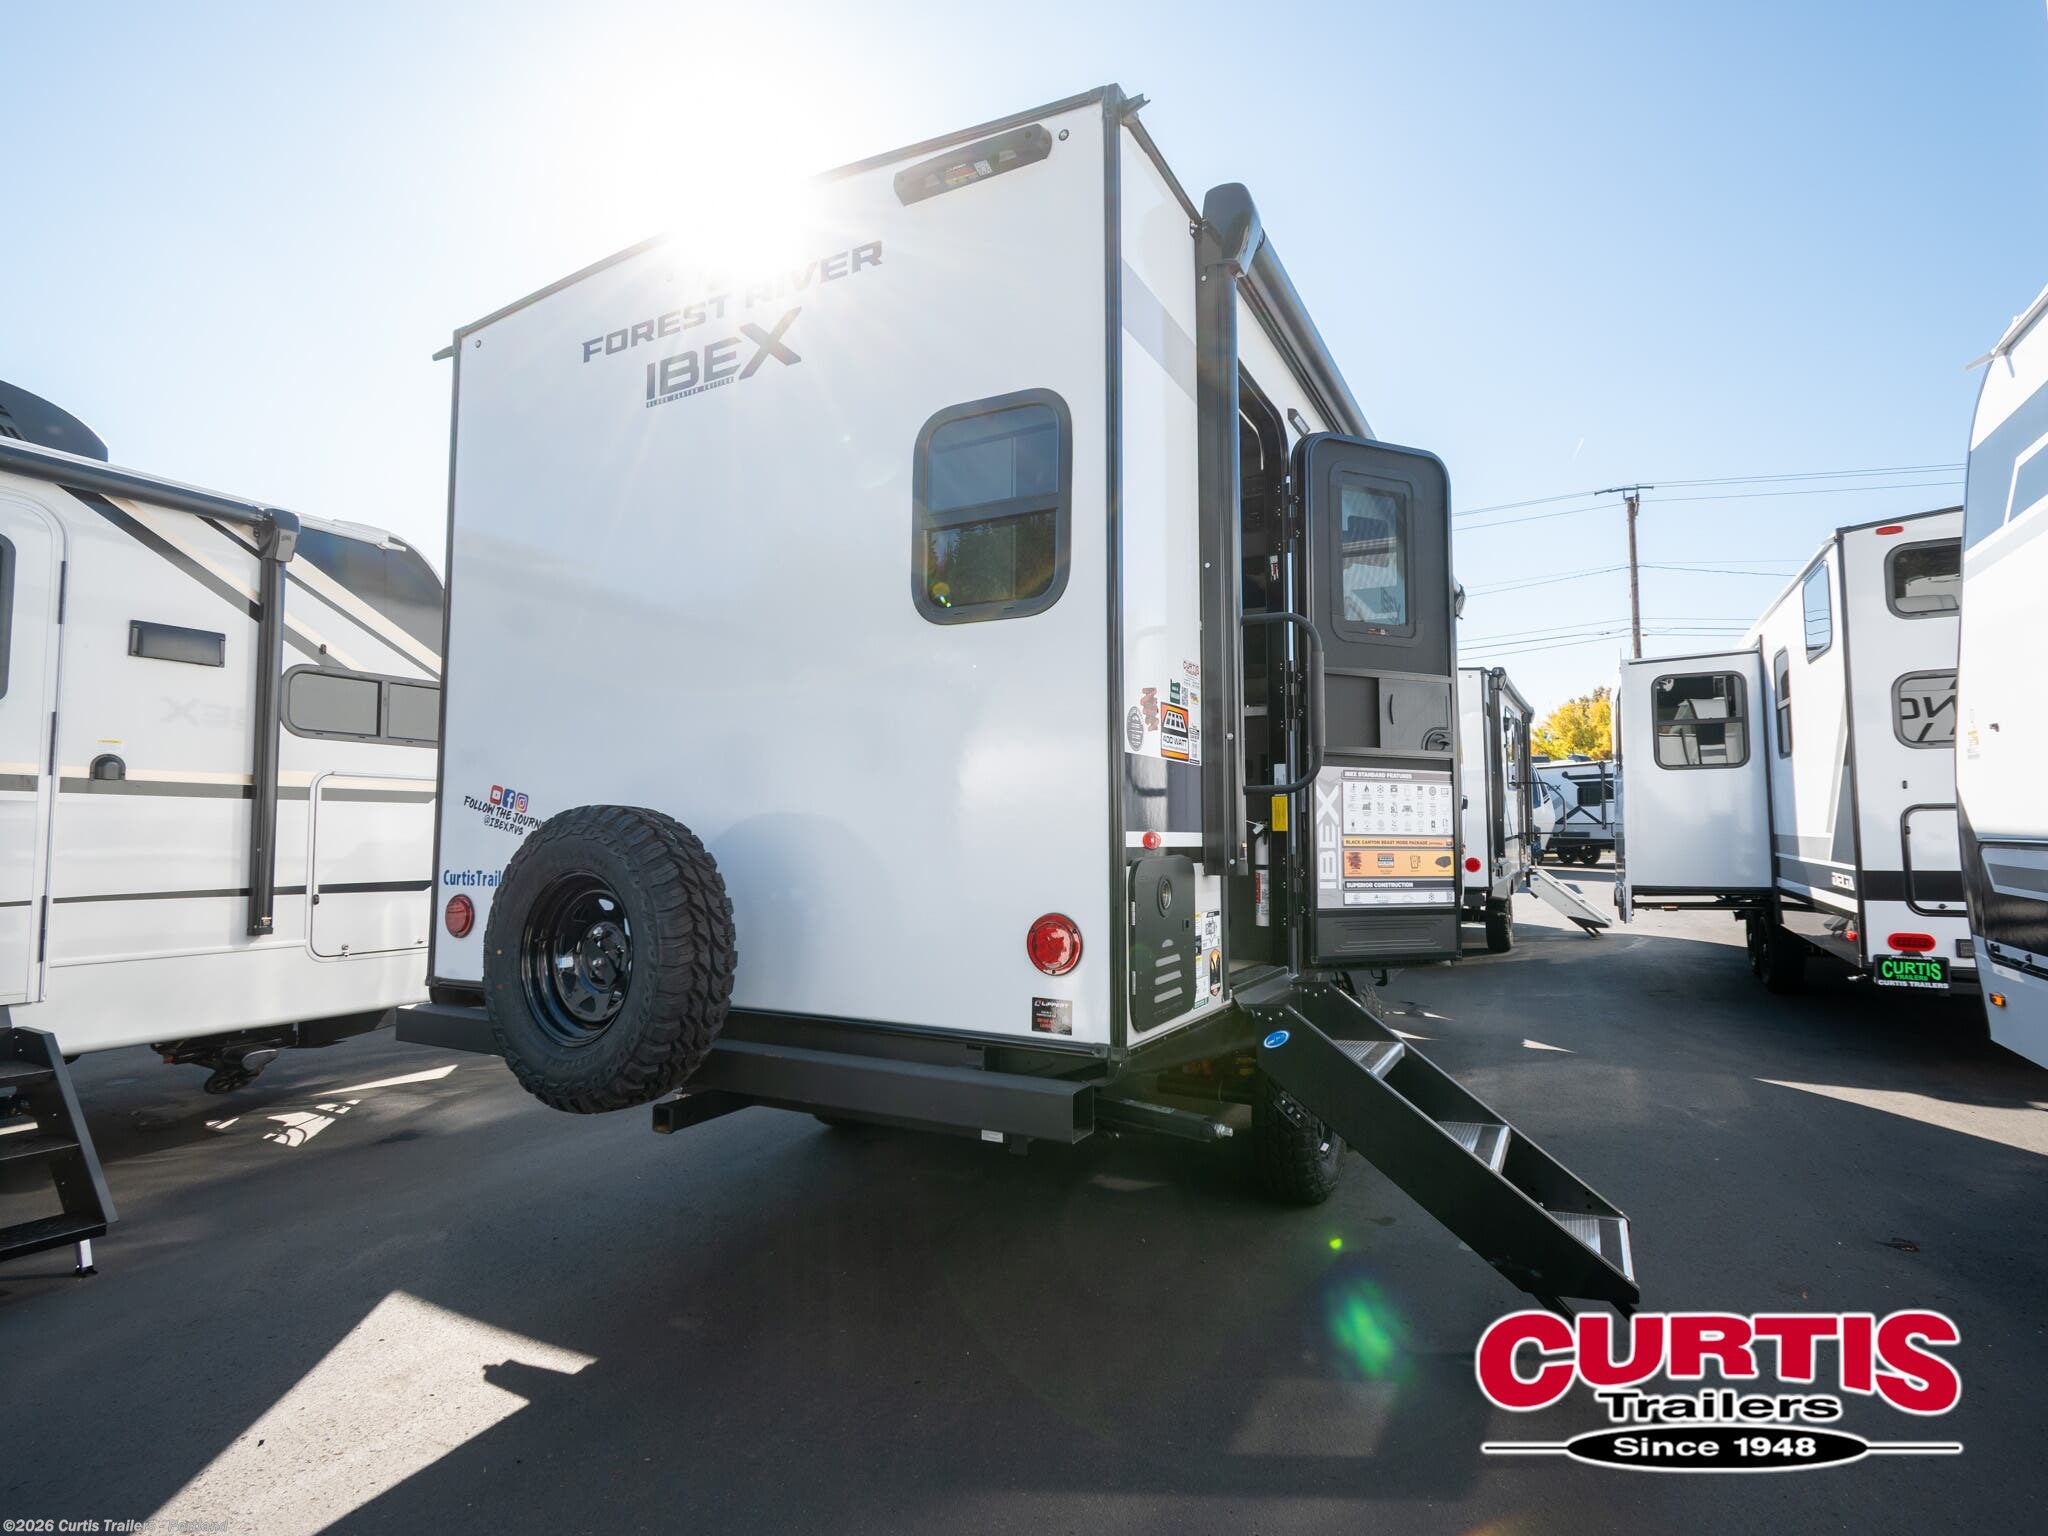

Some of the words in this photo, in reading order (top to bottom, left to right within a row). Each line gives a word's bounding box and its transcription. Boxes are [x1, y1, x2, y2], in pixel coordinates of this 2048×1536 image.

[582, 294, 729, 363] FOREST
[744, 240, 883, 308] RIVER
[646, 306, 802, 401] IBEX
[464, 796, 496, 816] FOLLOW
[496, 807, 512, 821] THE
[484, 815, 524, 836] @IBEXRVS
[1882, 960, 1942, 981] CURTIS
[1909, 981, 1950, 989] TRAILERS
